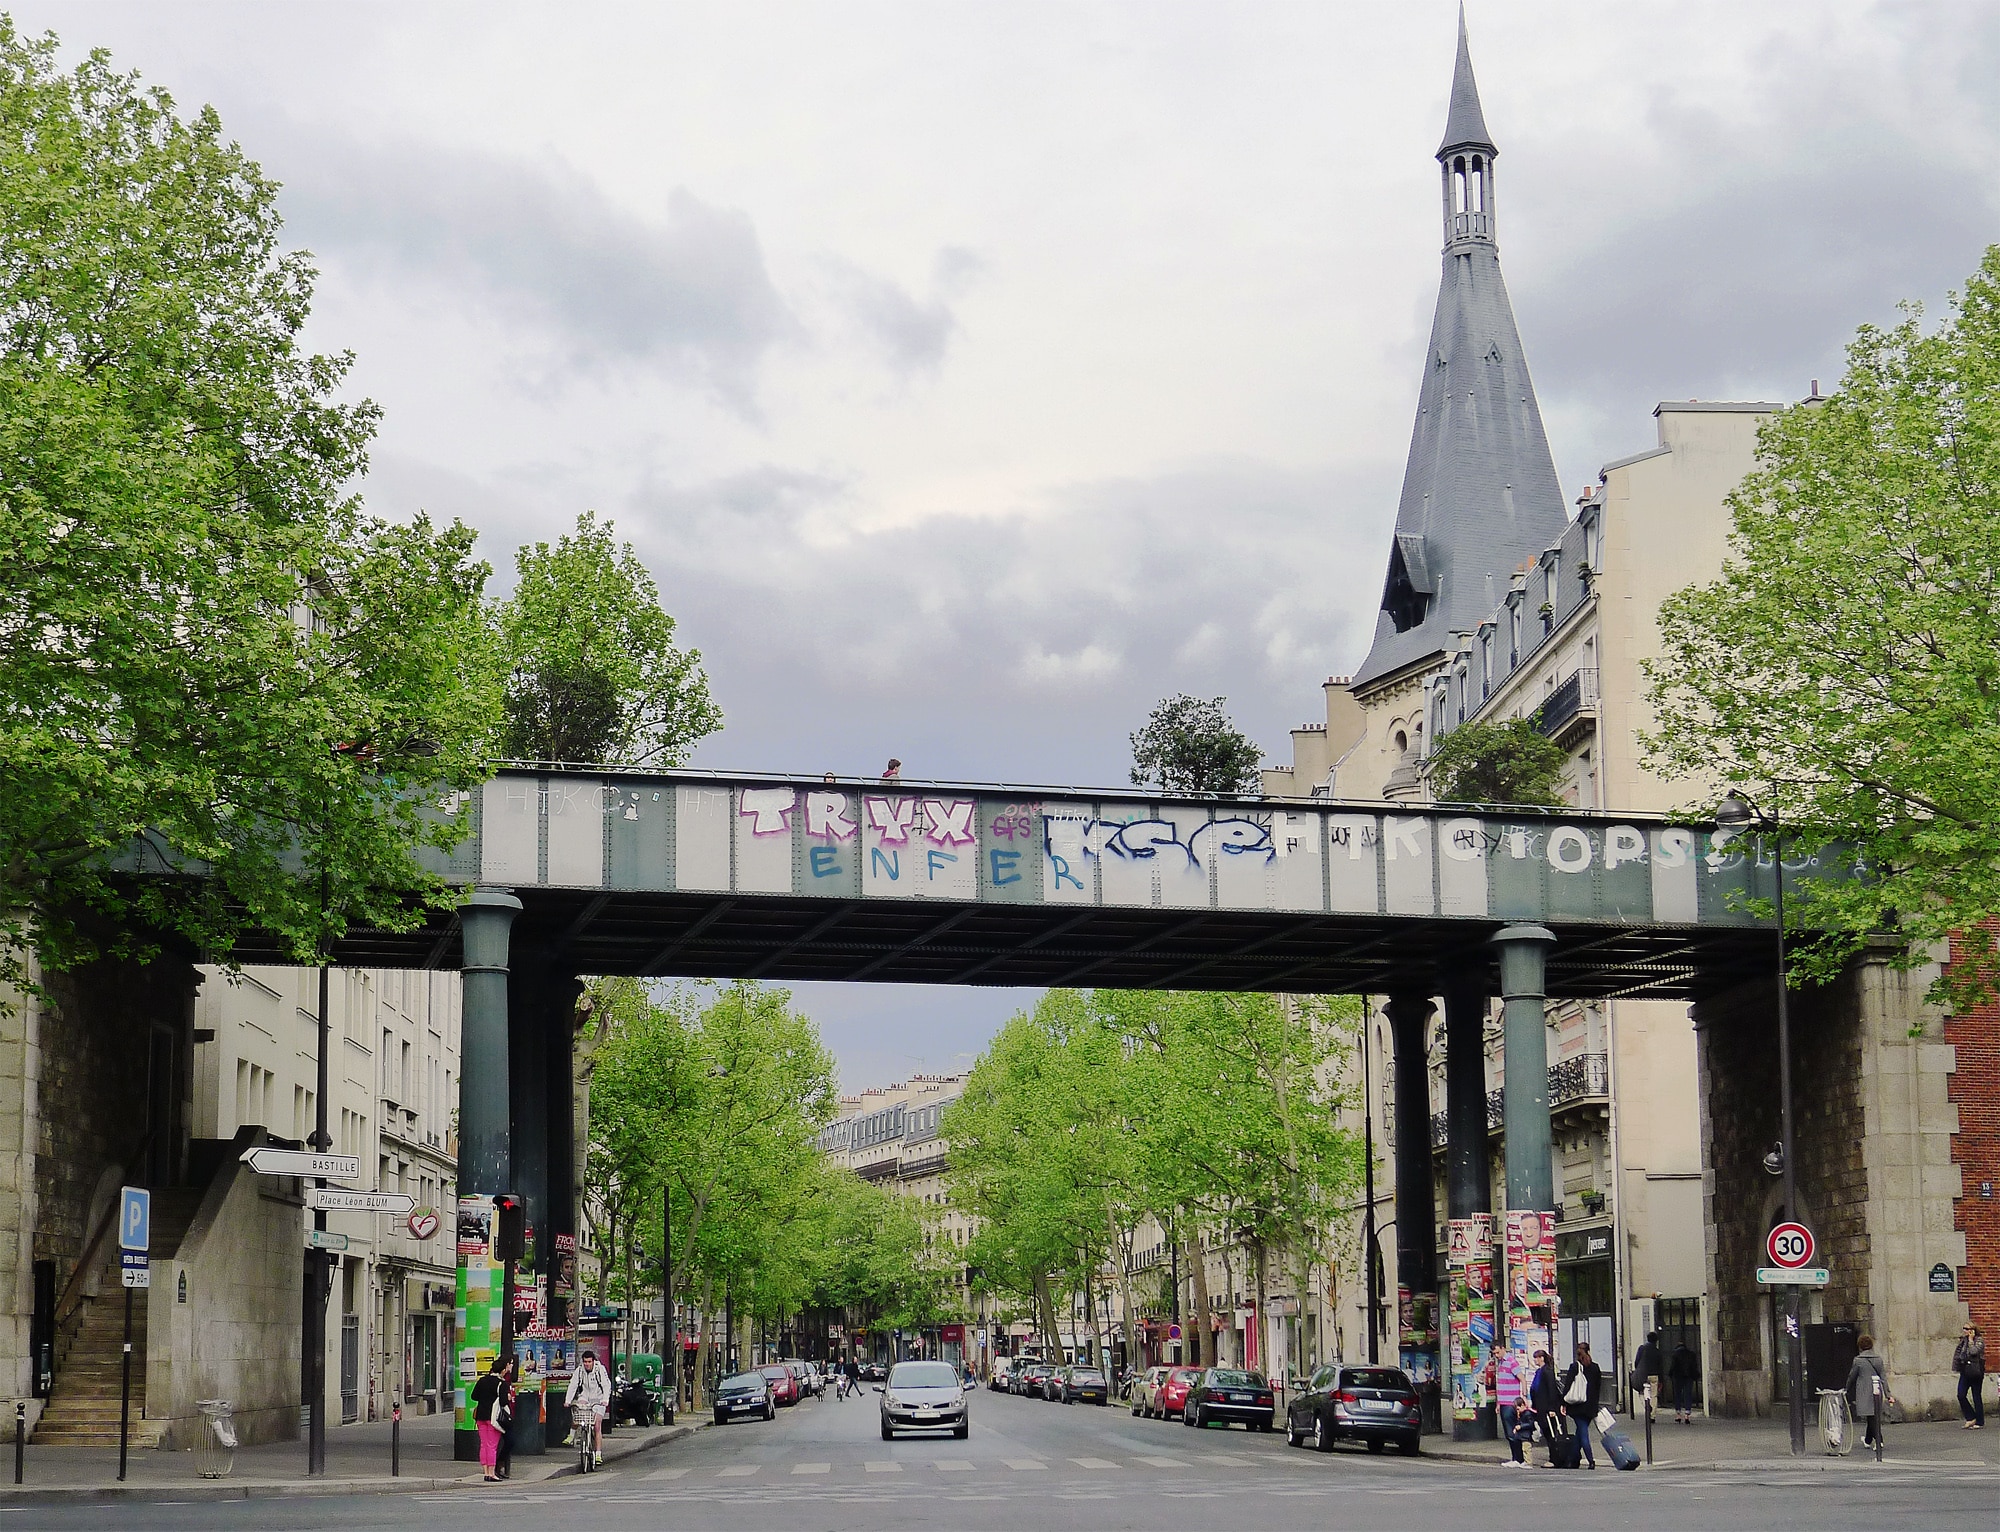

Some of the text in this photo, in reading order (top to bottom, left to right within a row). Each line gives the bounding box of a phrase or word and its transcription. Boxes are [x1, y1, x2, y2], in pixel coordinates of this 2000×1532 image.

[312, 1160, 356, 1172] BASTILLE
[1982, 1182, 1990, 1191] 13
[319, 1194, 341, 1206] Place
[366, 1197, 388, 1208] BLUM
[129, 1200, 142, 1237] P
[1777, 1236, 1805, 1256] 30
